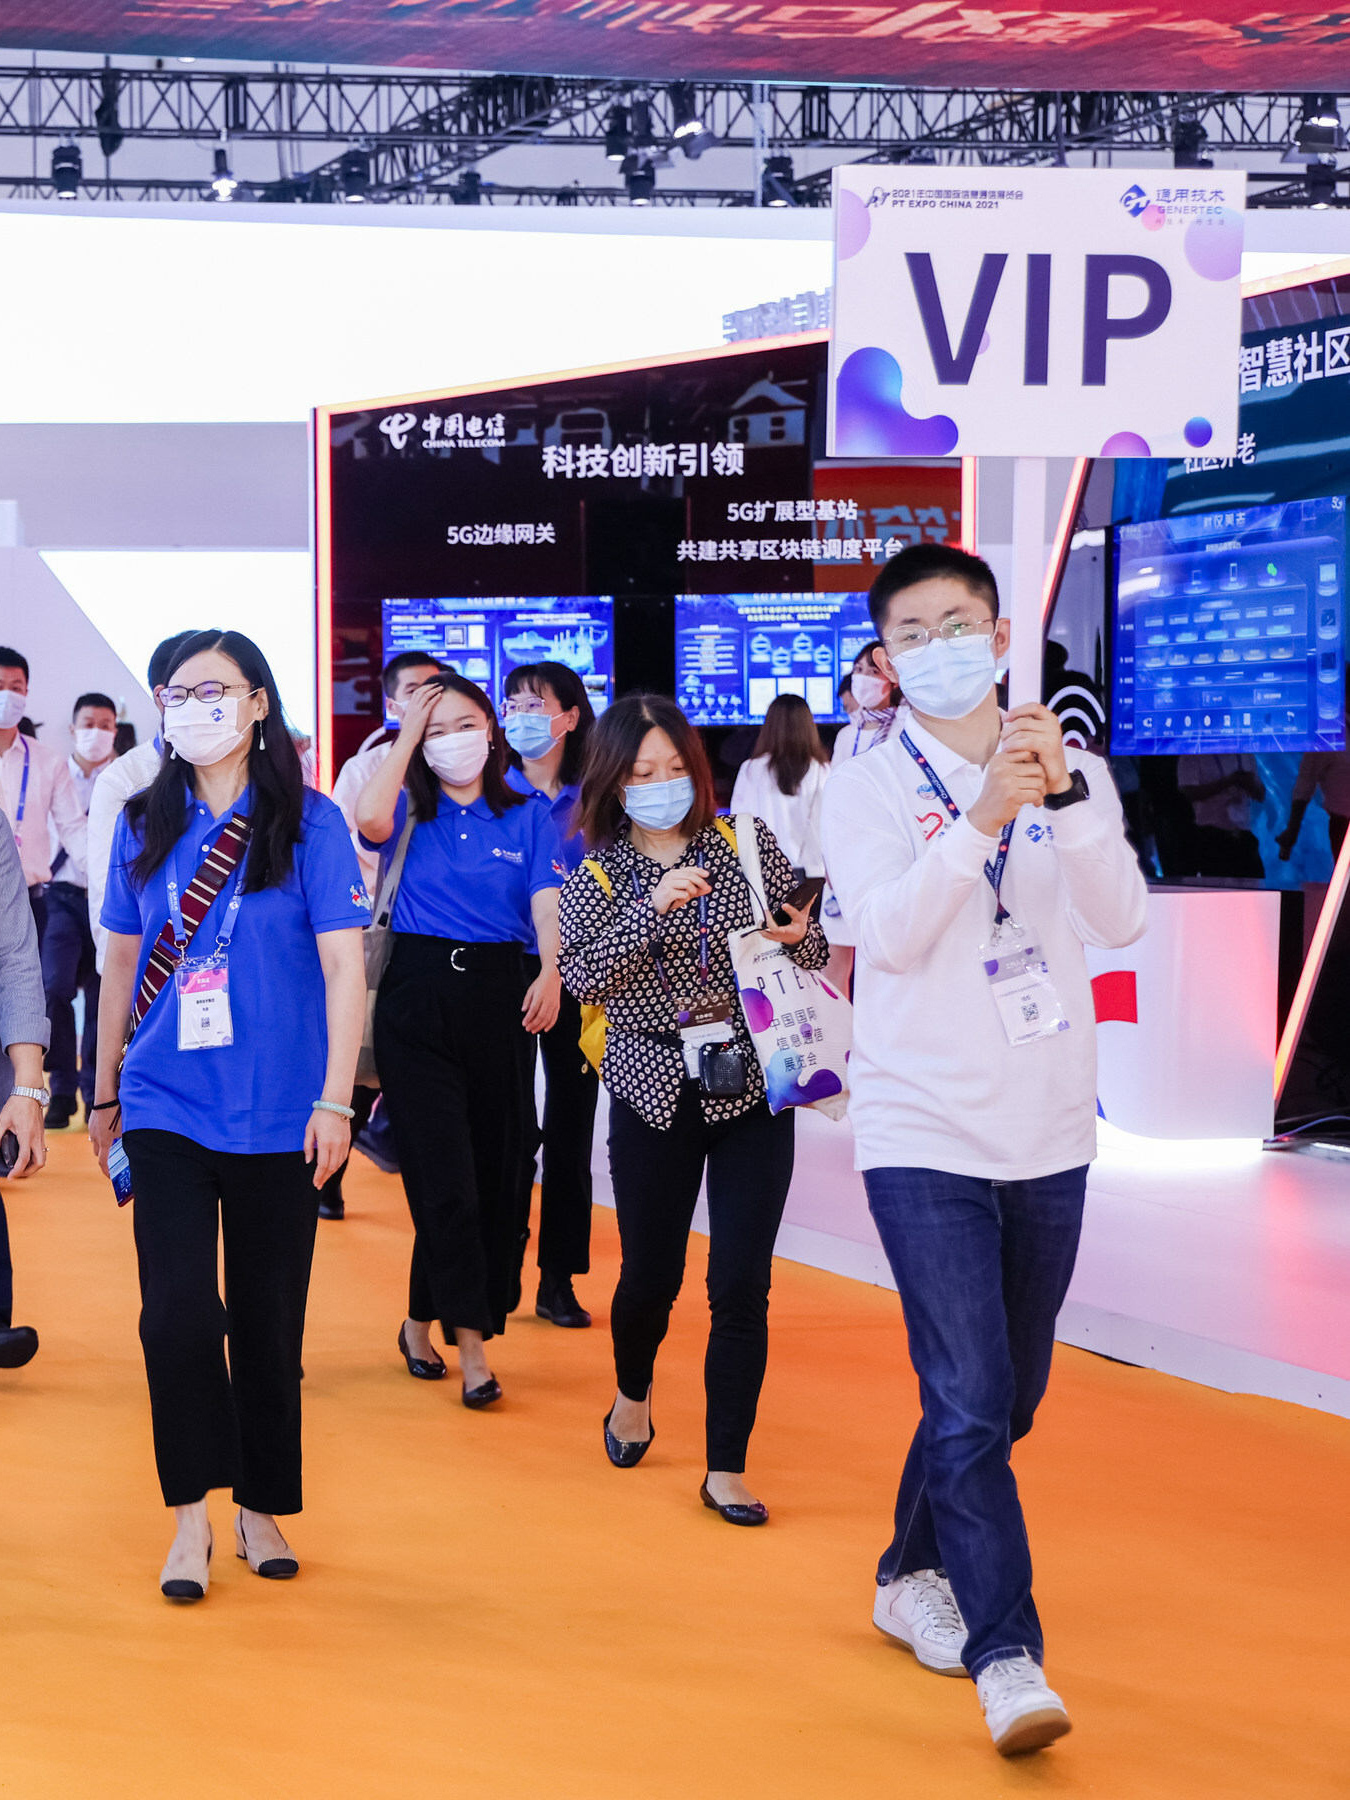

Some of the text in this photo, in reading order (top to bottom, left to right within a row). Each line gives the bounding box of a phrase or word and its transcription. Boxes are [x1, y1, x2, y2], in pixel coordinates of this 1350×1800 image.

[892, 200, 999, 209] PT EXPO CHINA 2021
[1155, 188, 1225, 204] 通用技术
[1158, 205, 1222, 215] GENERTEC
[904, 252, 1173, 386] VIP
[1238, 326, 1350, 394] 智慧社区
[421, 411, 506, 439] 中国电信
[422, 438, 506, 449] CHINA TELECOM
[541, 442, 745, 480] 科技创新引领
[726, 499, 858, 522] 5G扩展型基站
[447, 523, 556, 546] 5G边缘网关
[676, 538, 904, 562] 共建共享区块链调度平台
[770, 1006, 818, 1031] 中国国际
[784, 1051, 818, 1073] 展览会
